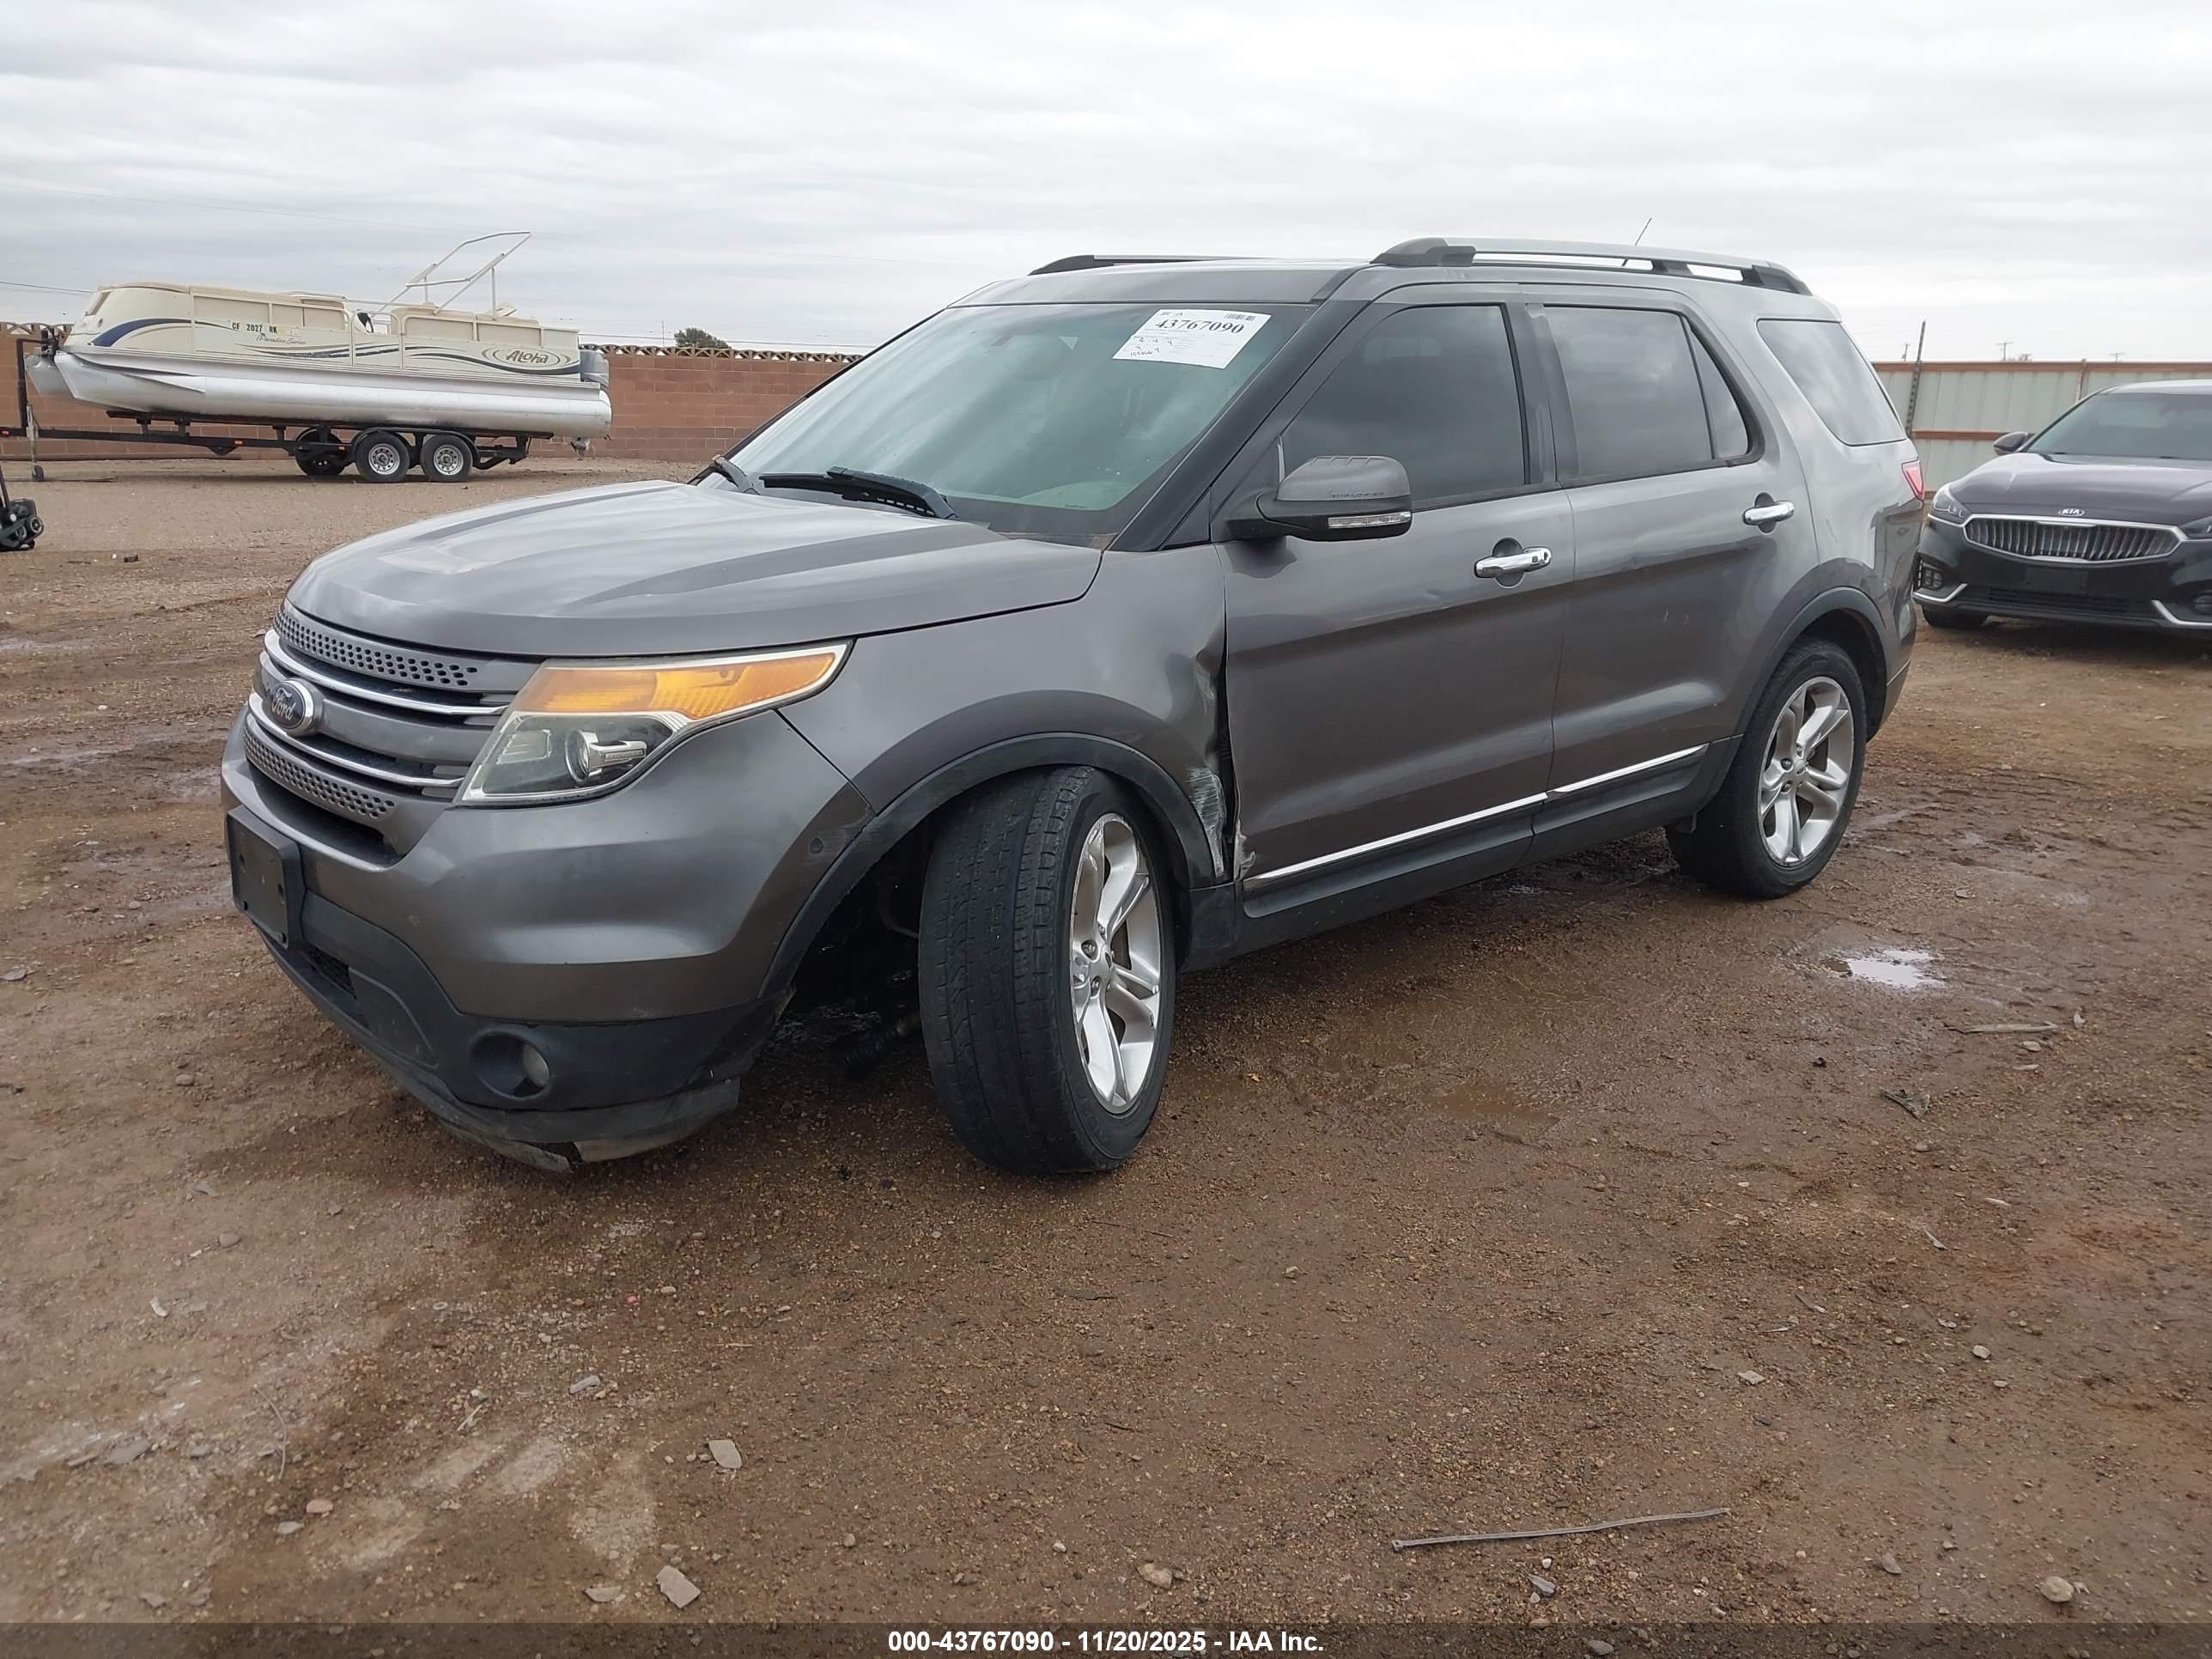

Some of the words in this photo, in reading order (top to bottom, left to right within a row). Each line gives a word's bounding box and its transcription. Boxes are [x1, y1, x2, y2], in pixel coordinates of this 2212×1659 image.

[246, 323, 263, 332] 2027
[1155, 319, 1245, 333] 43767090
[271, 687, 296, 720] Ford
